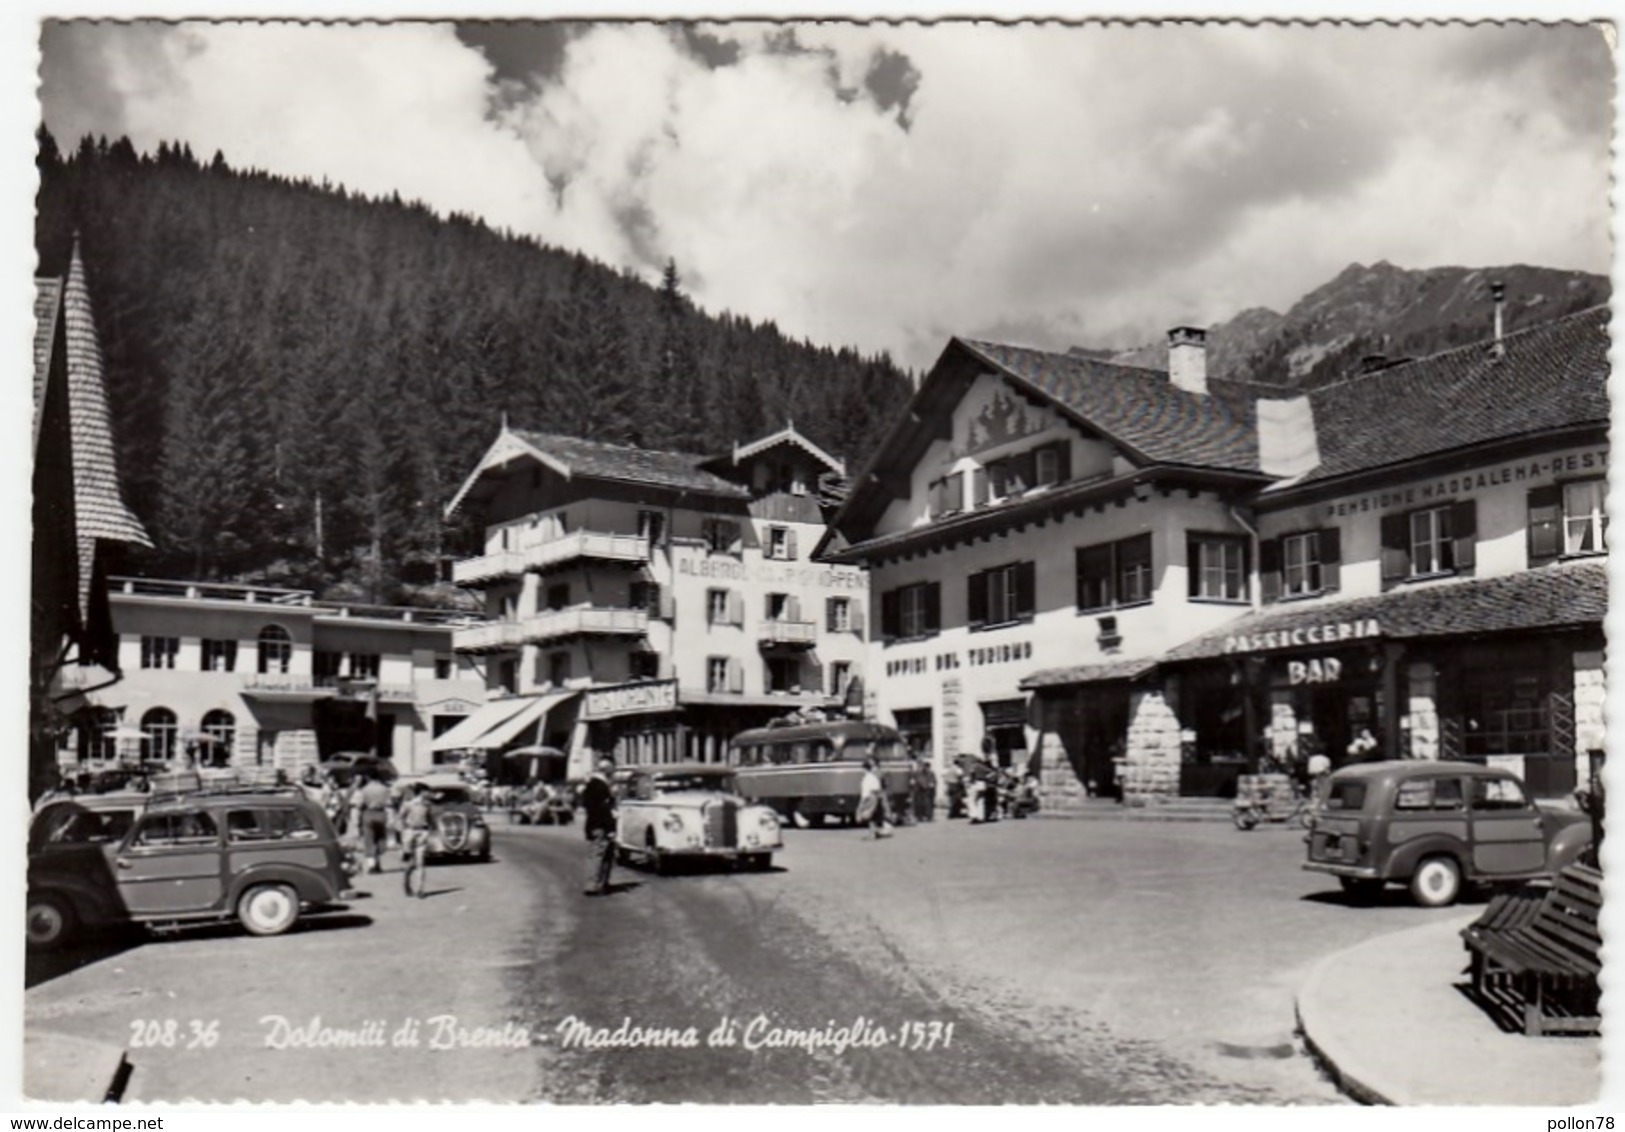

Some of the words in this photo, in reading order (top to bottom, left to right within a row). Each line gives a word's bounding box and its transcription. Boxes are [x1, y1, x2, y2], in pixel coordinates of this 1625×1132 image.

[1326, 489, 1415, 517] PENSIONE
[1224, 618, 1380, 654] PASTICCERIA
[936, 652, 960, 671] DEL
[968, 641, 1033, 666] TURISMO
[1287, 657, 1342, 685] BAR
